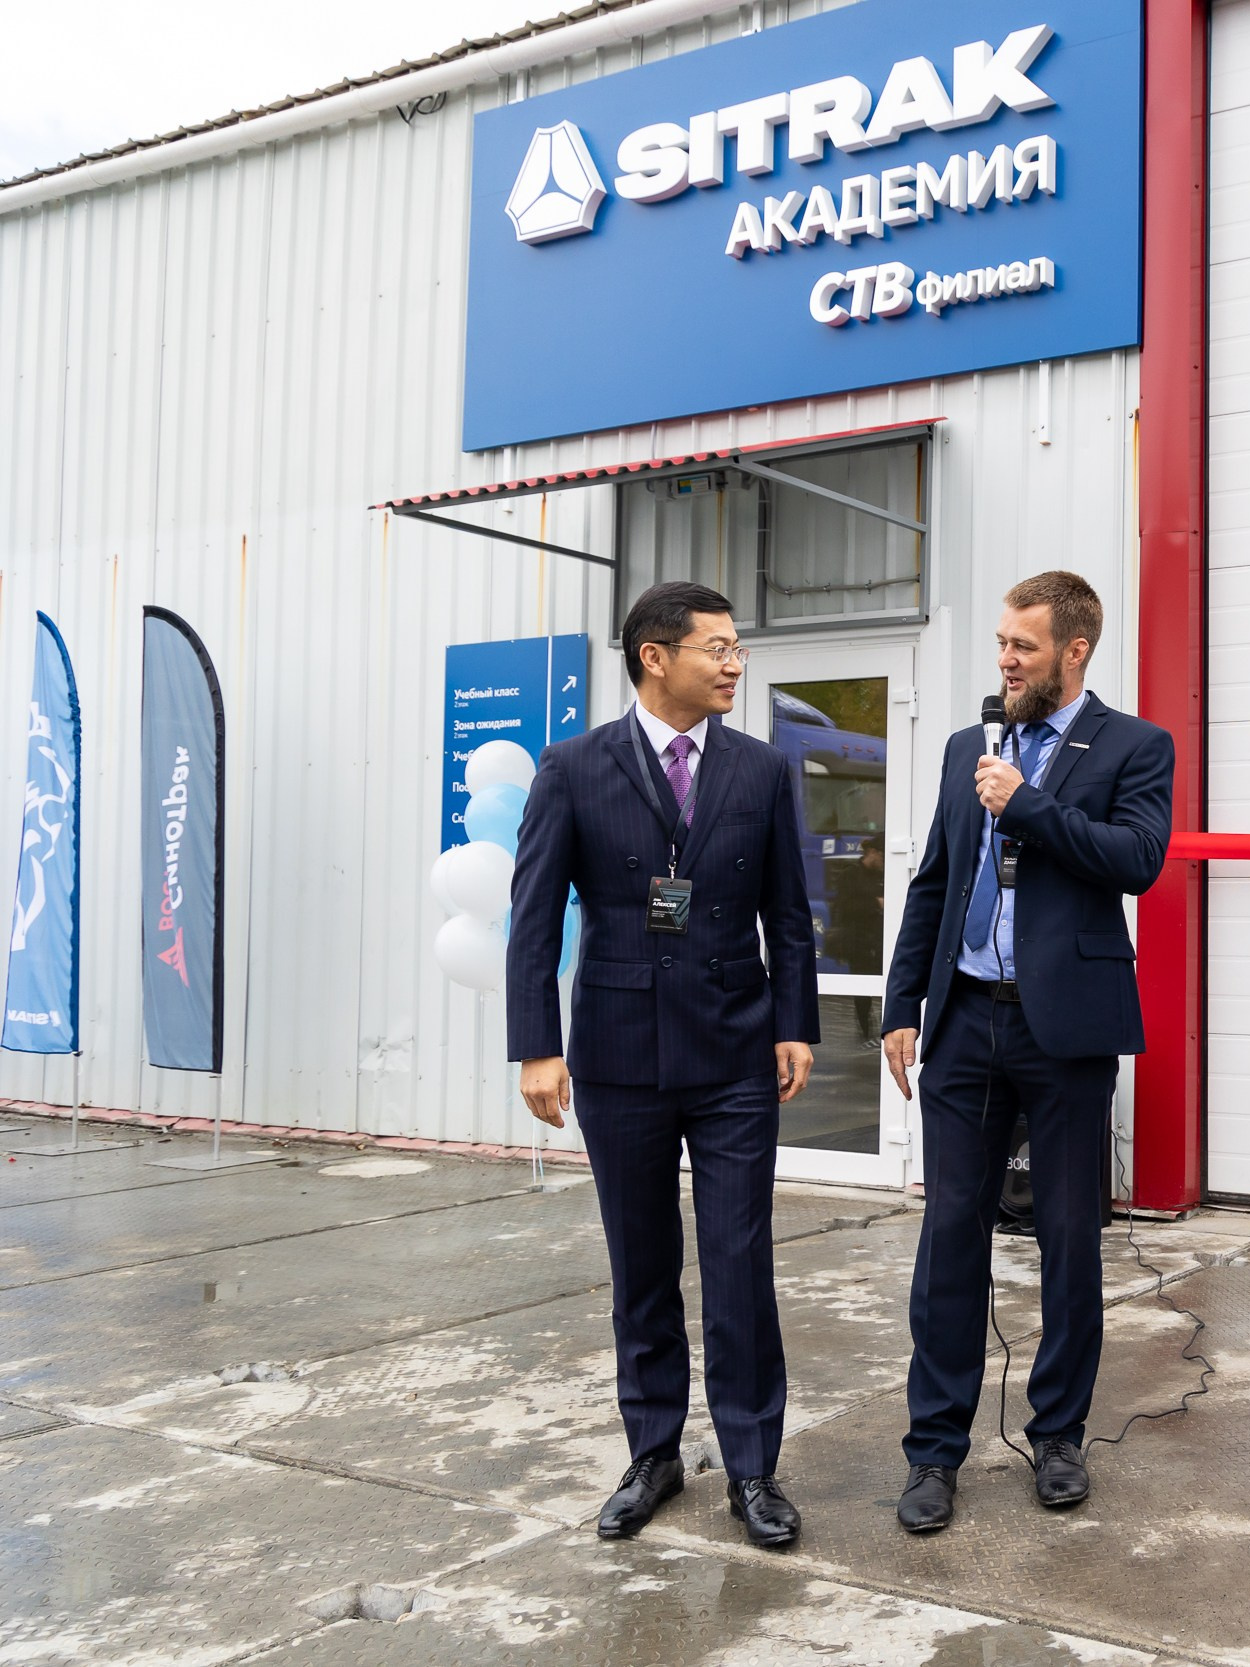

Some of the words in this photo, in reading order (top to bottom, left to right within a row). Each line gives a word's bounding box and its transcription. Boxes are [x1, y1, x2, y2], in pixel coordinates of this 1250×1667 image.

[614, 23, 1057, 203] SITRAK
[724, 134, 1057, 259] АКАДЕМИЯ
[809, 261, 915, 327] СТВ
[916, 256, 1055, 316] филиал
[453, 720, 475, 731] Зона
[476, 719, 522, 730] ожидания
[454, 687, 493, 700] Учебный
[494, 687, 520, 697] класс
